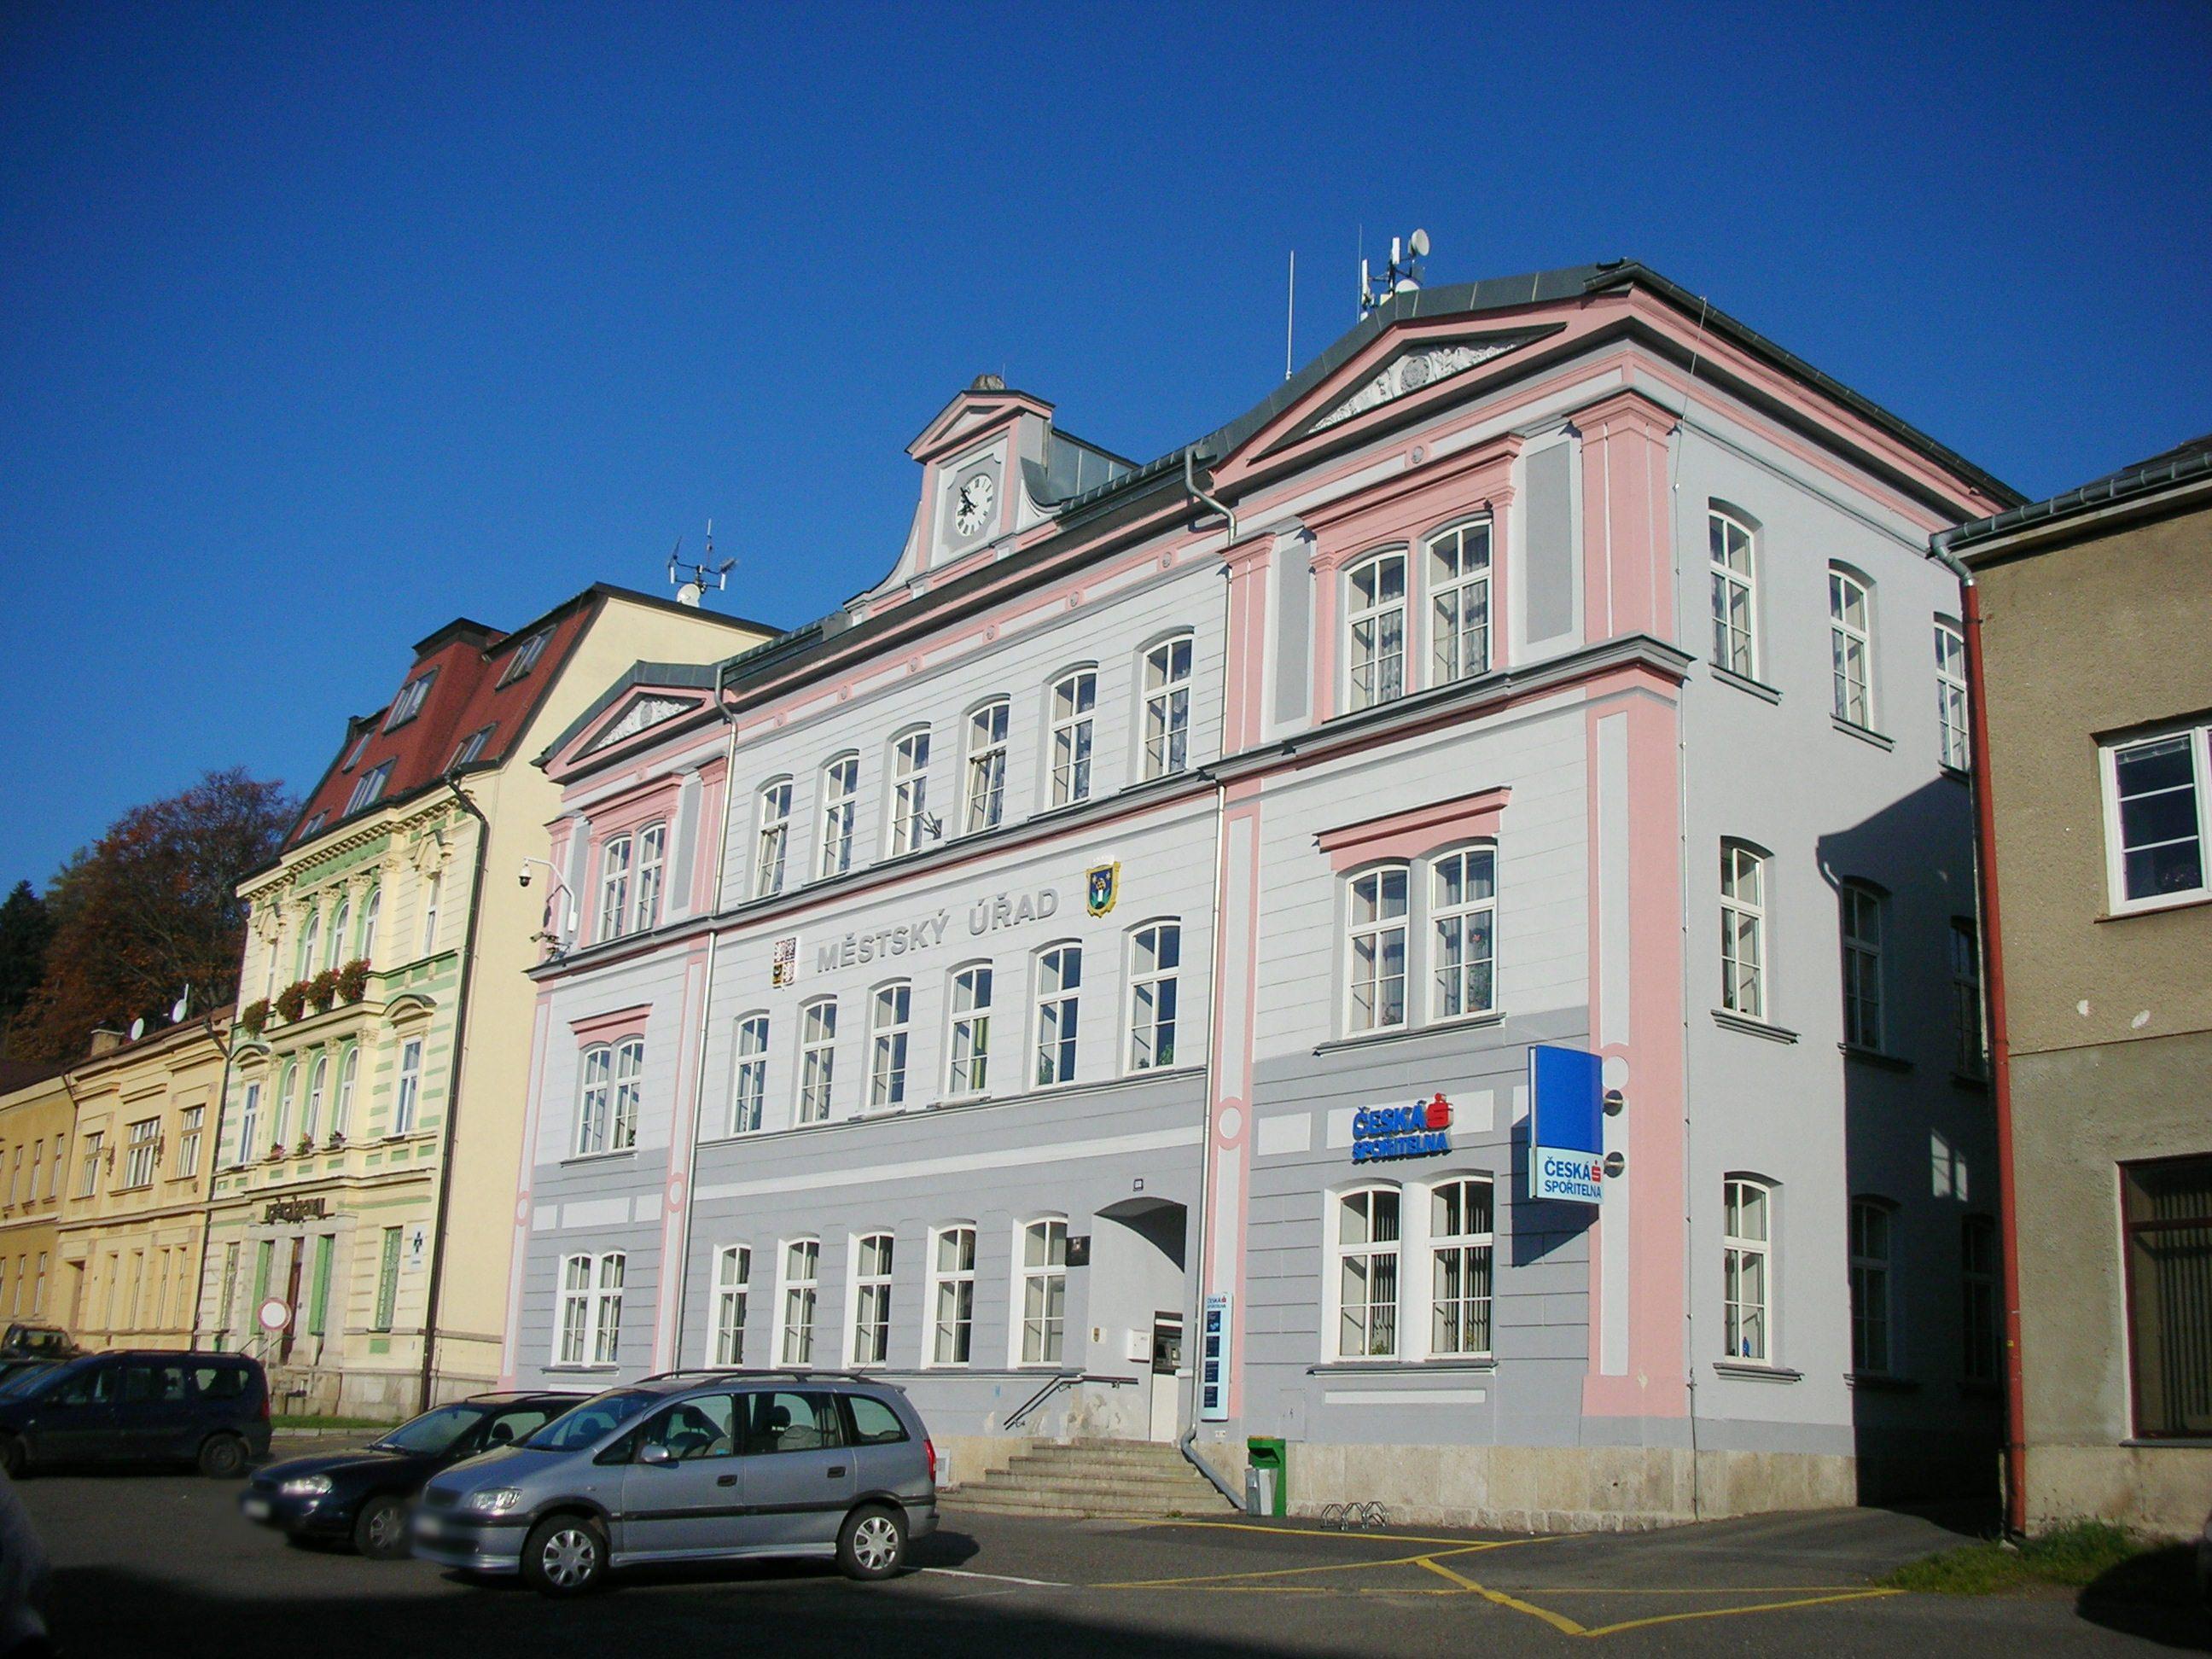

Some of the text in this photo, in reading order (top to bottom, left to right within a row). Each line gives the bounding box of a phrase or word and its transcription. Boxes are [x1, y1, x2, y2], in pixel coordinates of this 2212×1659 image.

[817, 888, 1059, 973] MĚSTSKÝ ÚŘAD
[1353, 1099, 1426, 1140] ČESKÁ
[1544, 1155, 1592, 1181] ČESKÁ
[1544, 1178, 1602, 1198] SPOŘITELNA
